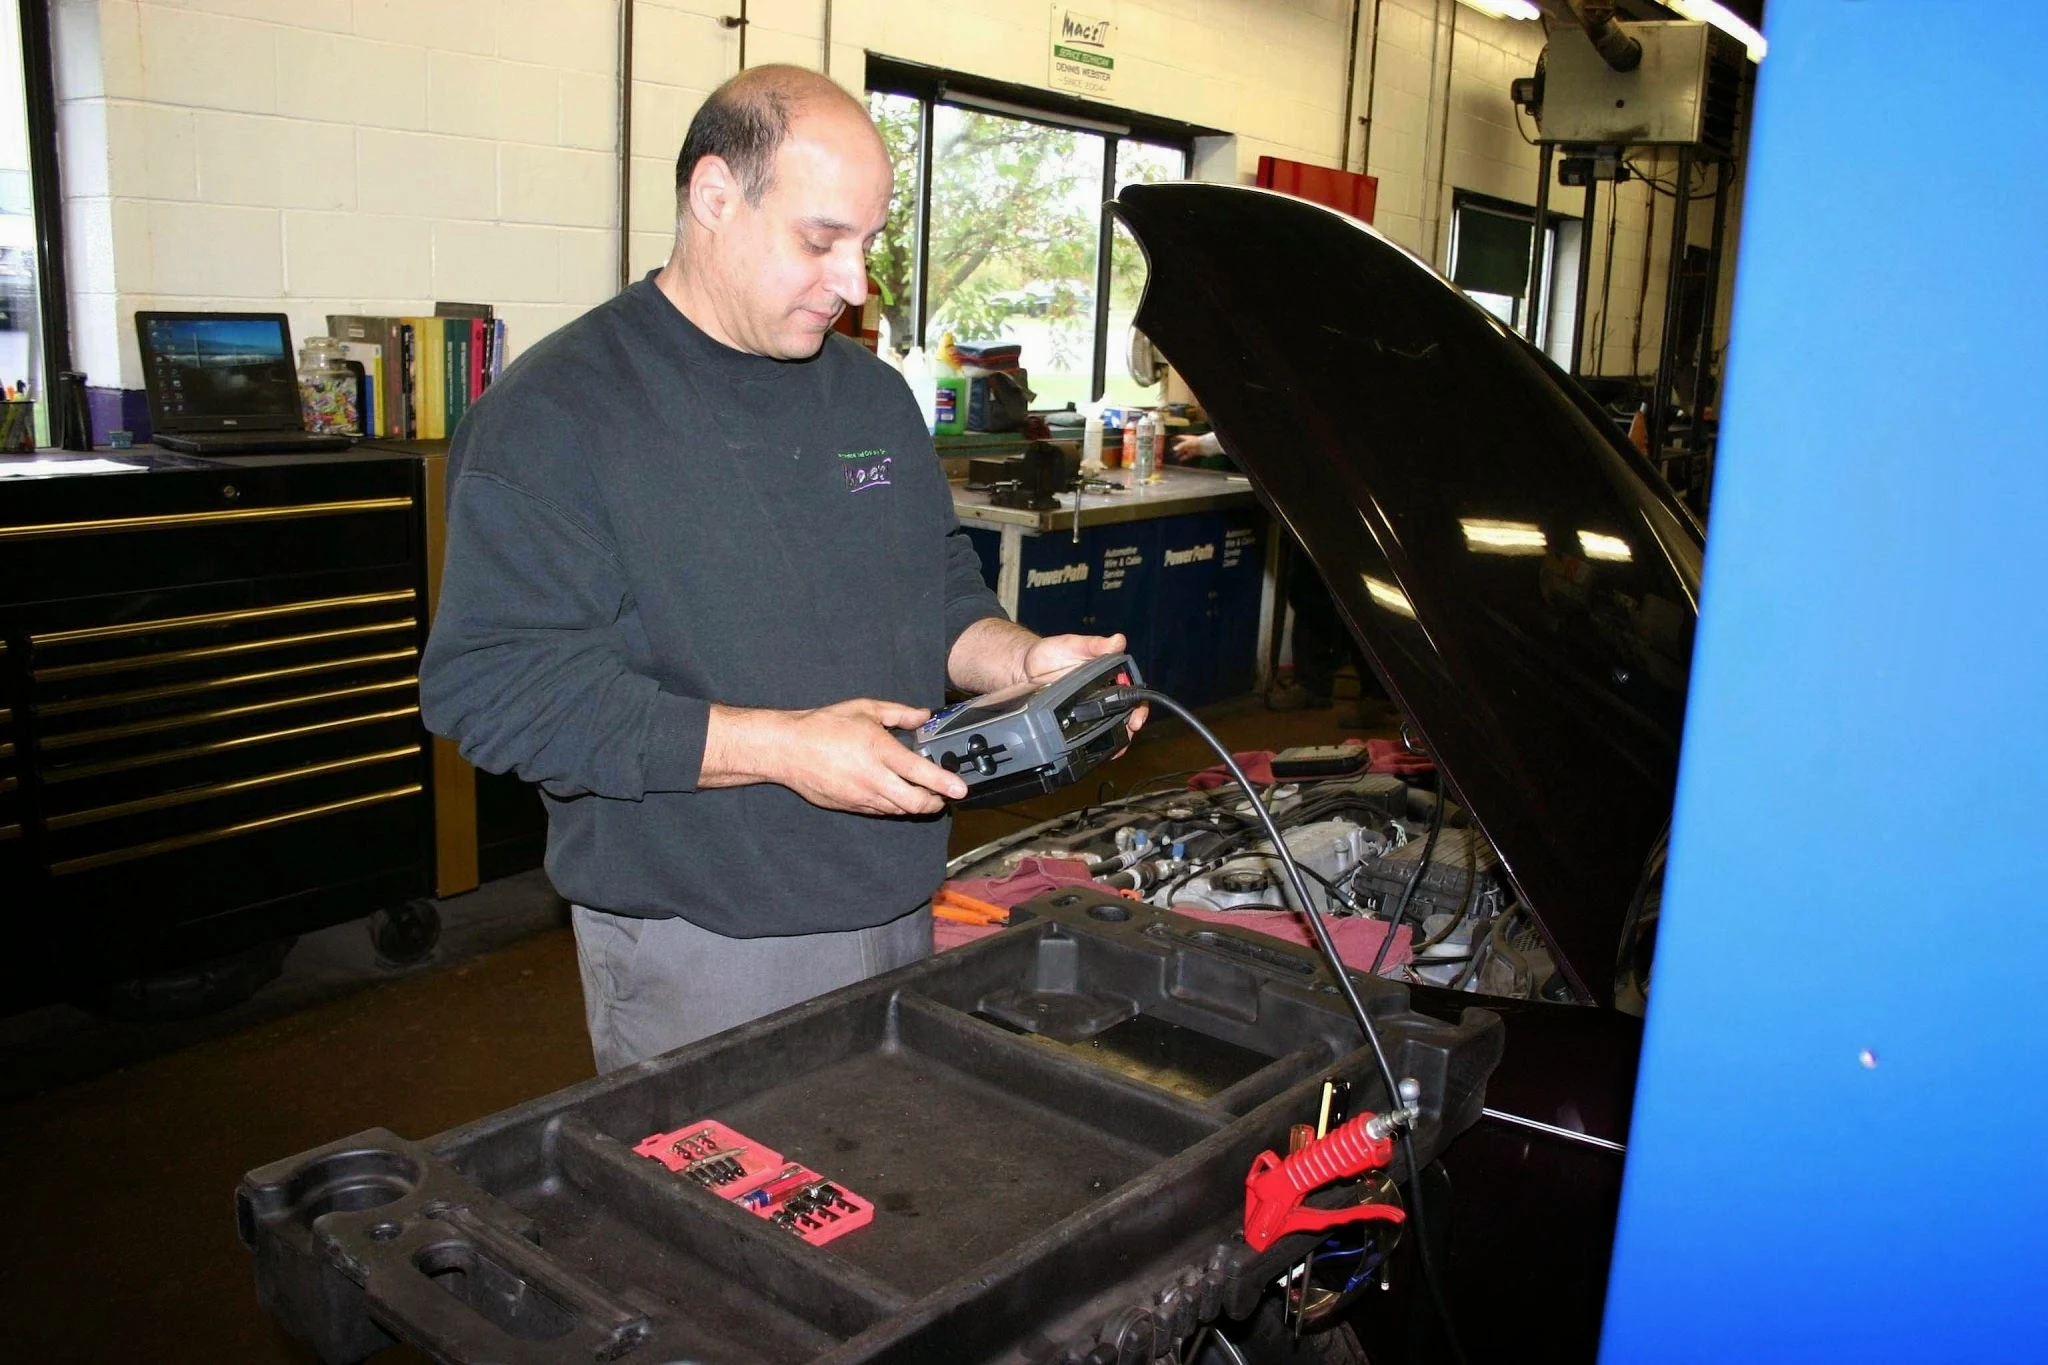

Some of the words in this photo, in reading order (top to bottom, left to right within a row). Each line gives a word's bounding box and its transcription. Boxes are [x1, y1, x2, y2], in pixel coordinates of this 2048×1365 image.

[1056, 62, 1080, 75] DENNIS
[1082, 69, 1111, 81] WEBSTER
[1164, 543, 1215, 567] PowerPath
[1026, 563, 1089, 588] PowerPath
